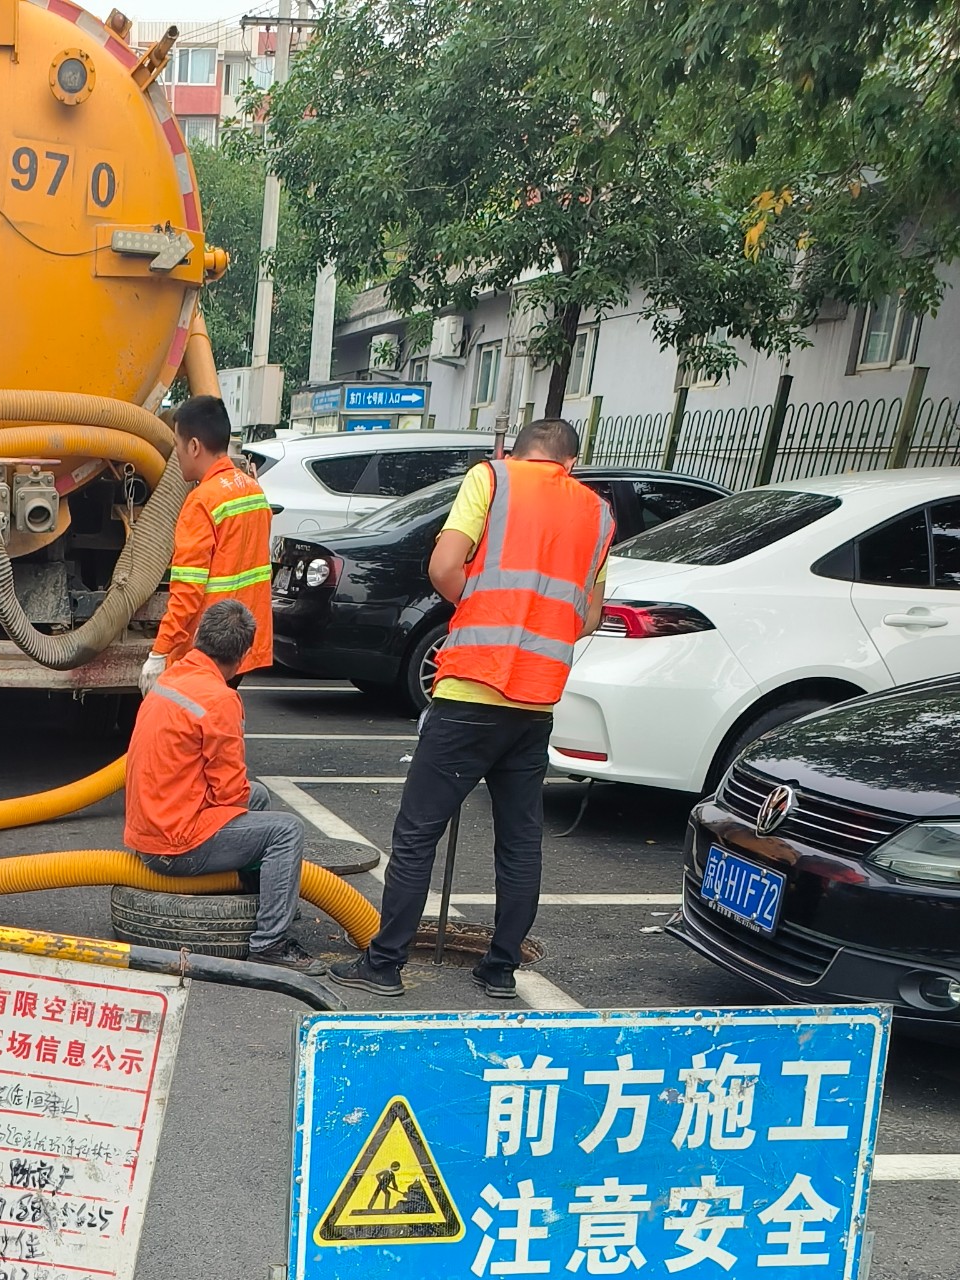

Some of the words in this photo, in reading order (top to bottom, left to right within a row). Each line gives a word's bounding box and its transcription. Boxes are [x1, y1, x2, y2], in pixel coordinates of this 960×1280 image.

[481, 1050, 852, 1160] 前方施工
[468, 1172, 842, 1279] 注意安全
